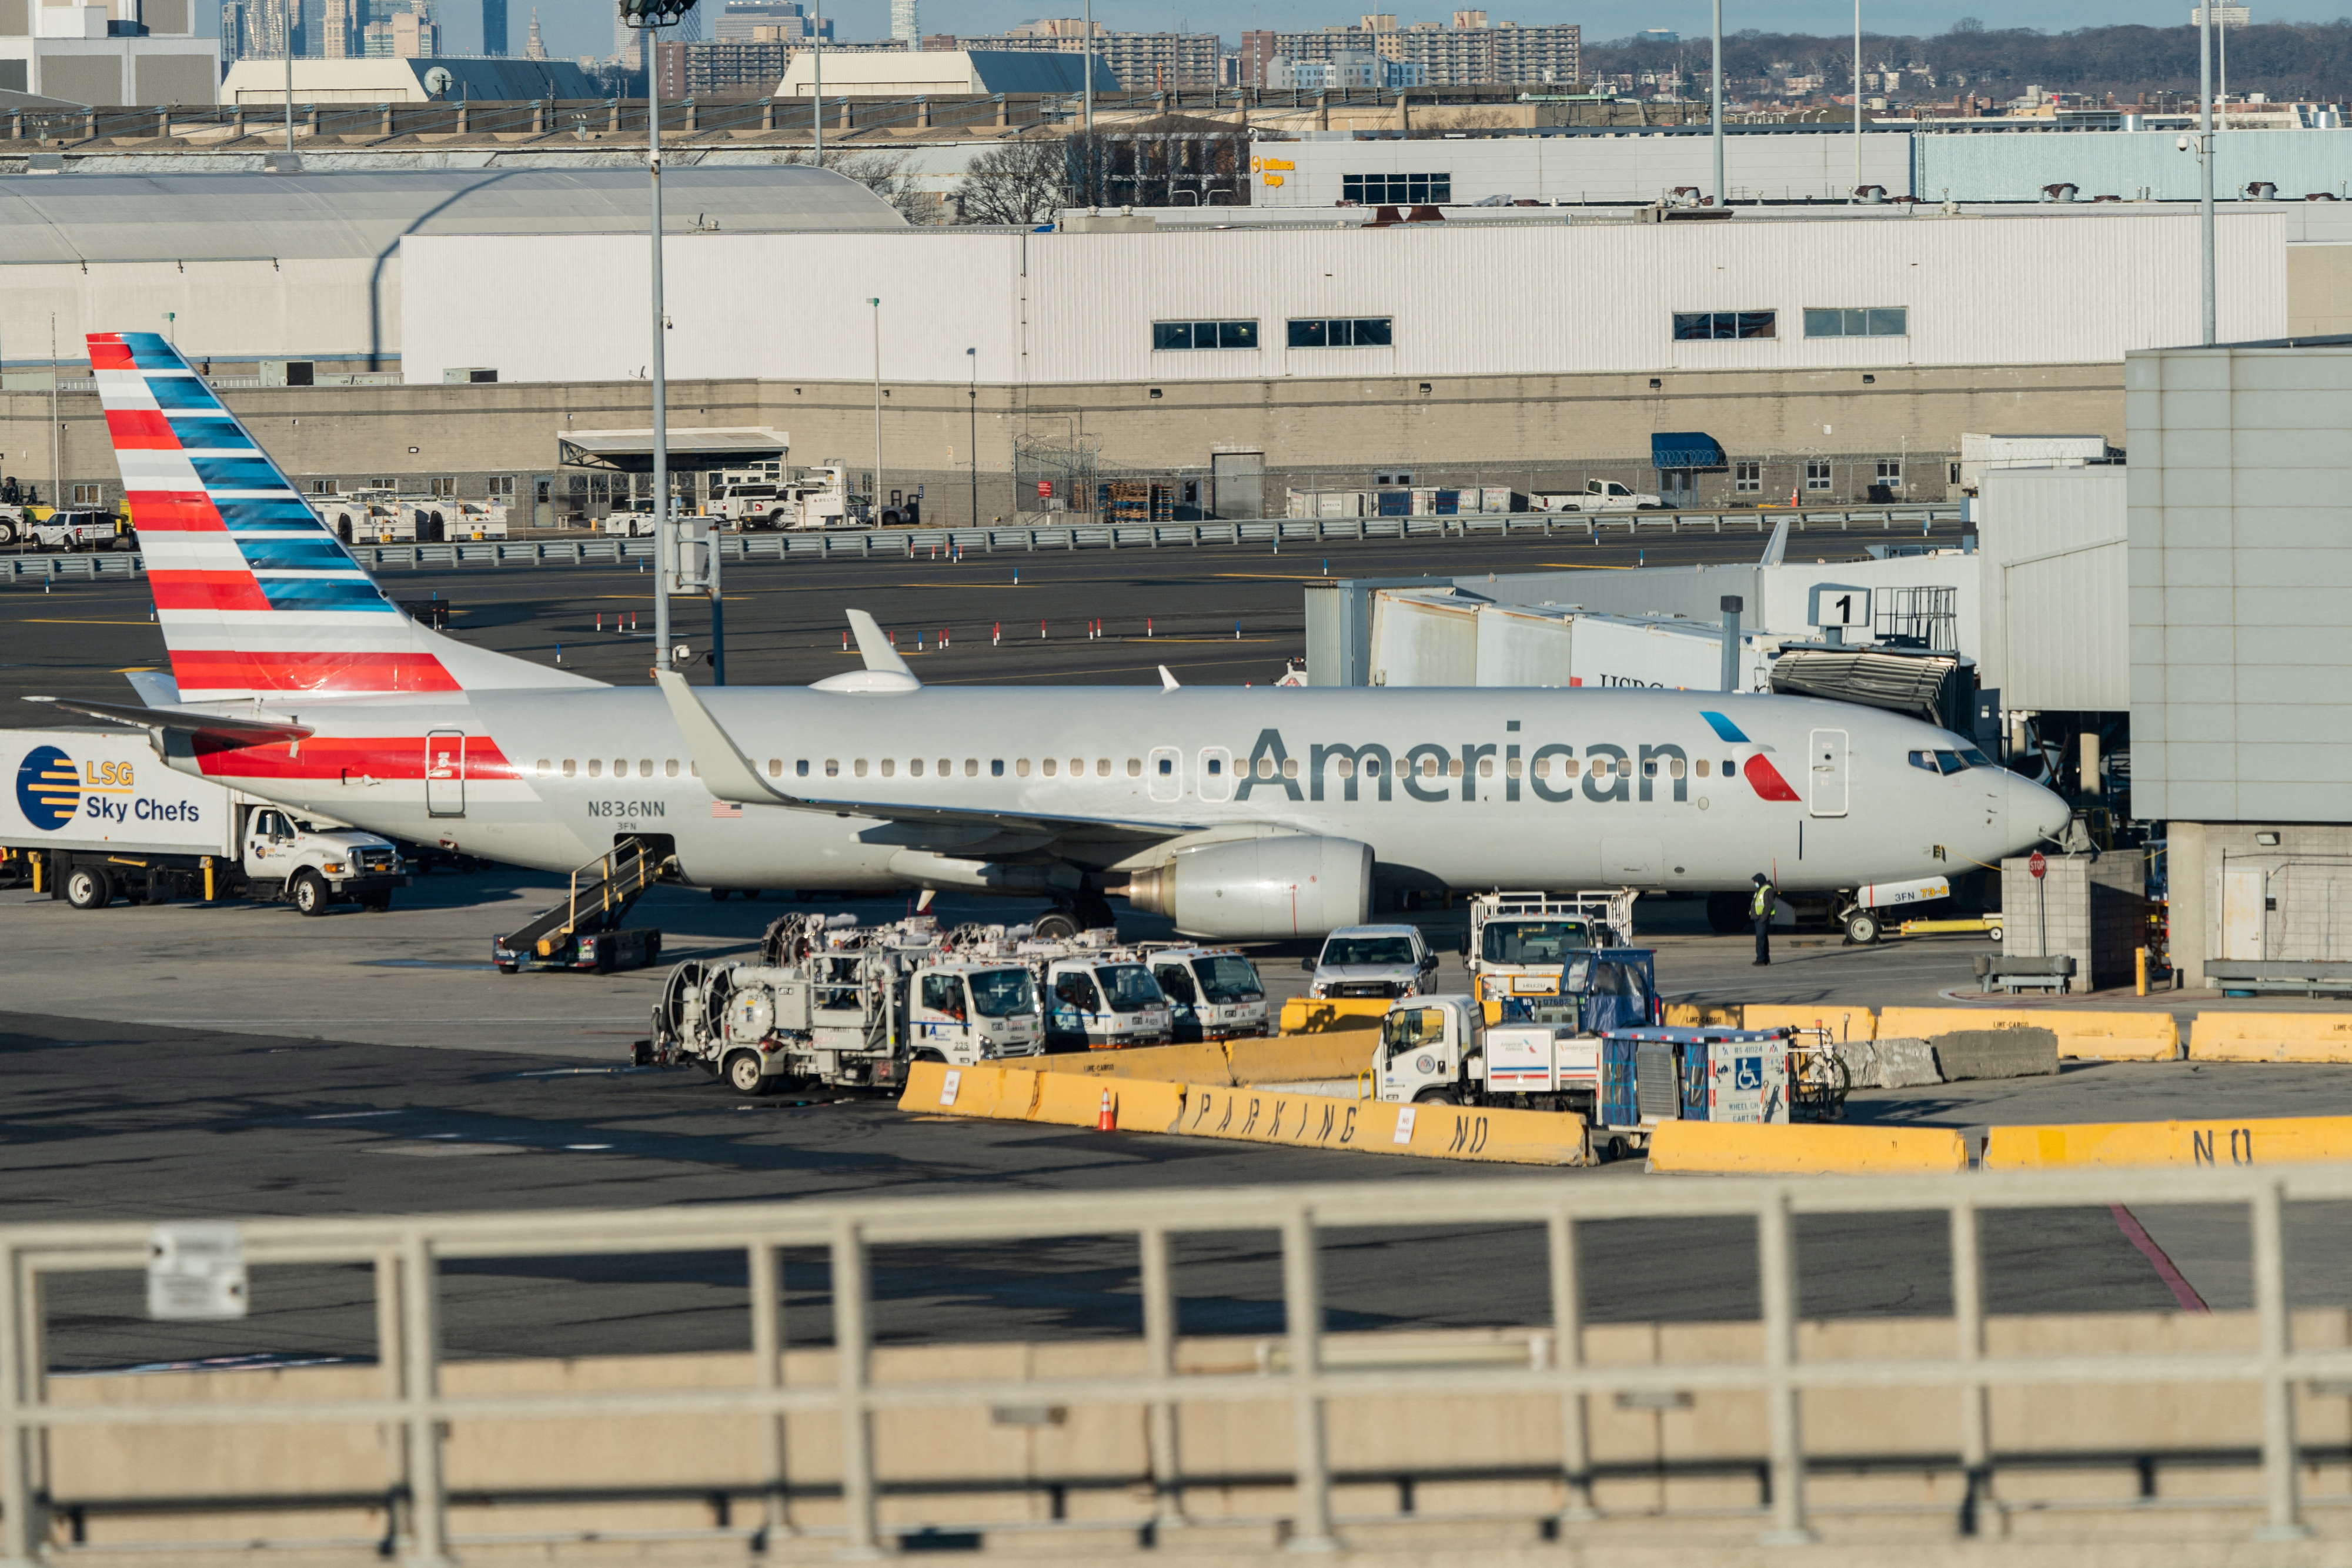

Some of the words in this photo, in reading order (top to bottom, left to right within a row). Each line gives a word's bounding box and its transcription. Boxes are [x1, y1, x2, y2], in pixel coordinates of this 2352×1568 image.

[1836, 595, 1850, 623] 1
[86, 761, 133, 786] LSG
[1234, 720, 1688, 803] American
[86, 796, 128, 824] Sky
[135, 798, 199, 822] Chefs
[588, 801, 664, 817] N836NN
[2030, 860, 2045, 871] STOP
[1895, 891, 1915, 902] 3FN
[1920, 885, 1949, 898] 73-8
[1745, 1045, 1763, 1054] 41024
[1084, 1064, 1114, 1072] LINE-CARGO
[1192, 1094, 1357, 1143] PARKING
[1729, 1102, 1749, 1111] WHEEL
[1448, 1116, 1488, 1153] NO
[2193, 1129, 2253, 1168] NO
